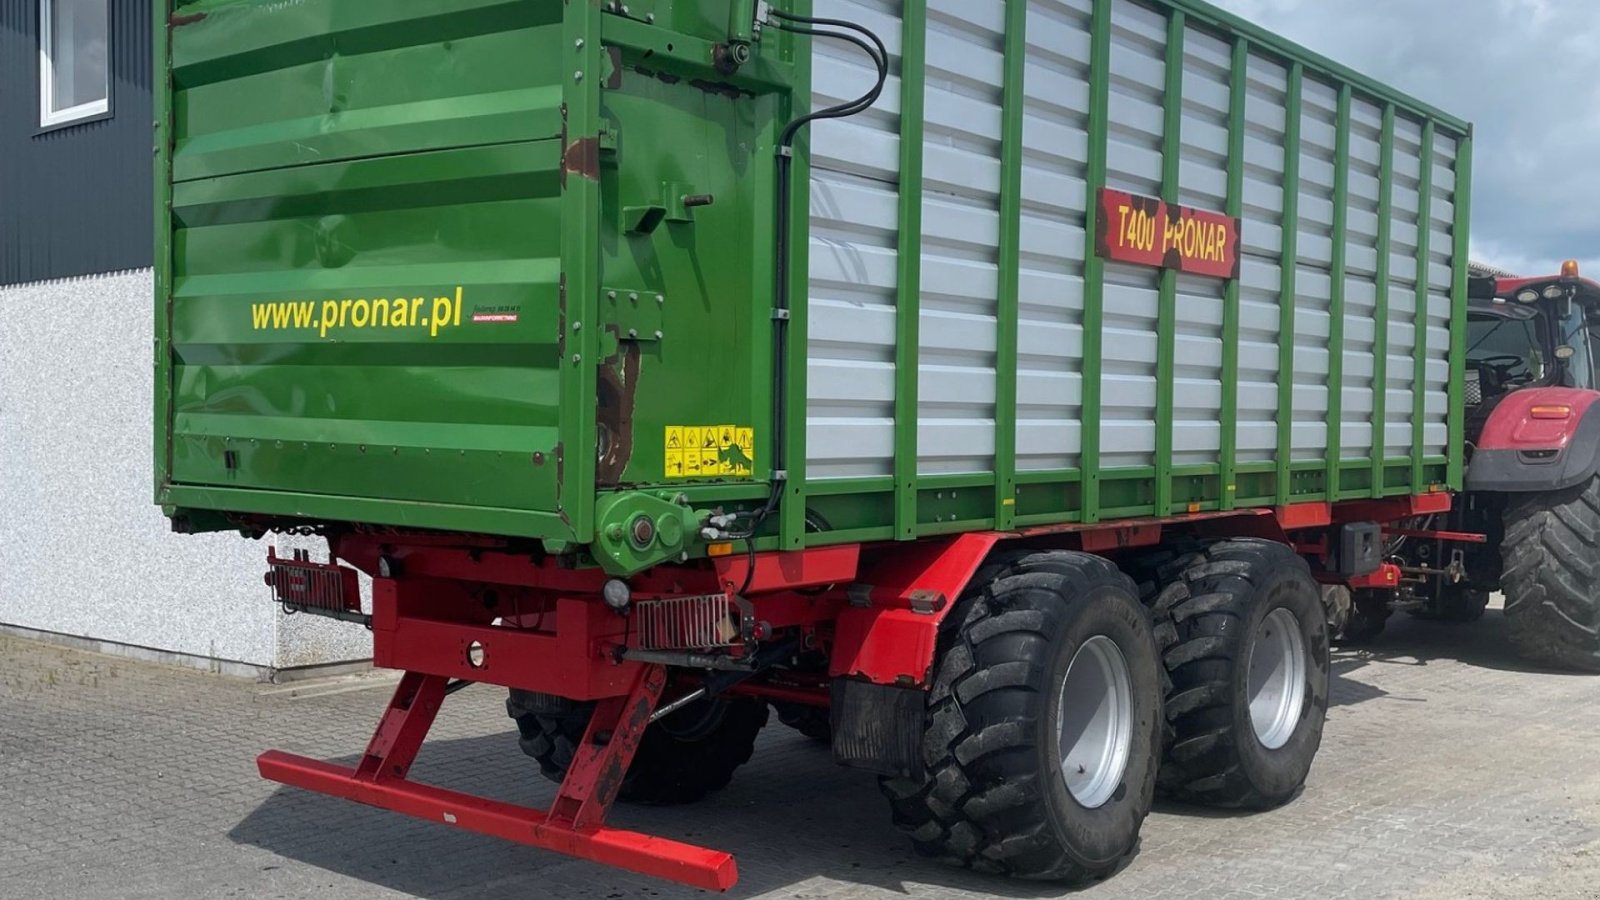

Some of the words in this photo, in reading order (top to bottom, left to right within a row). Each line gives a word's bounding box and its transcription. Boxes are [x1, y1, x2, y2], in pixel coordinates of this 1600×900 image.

[1118, 205, 1156, 252] T400
[1162, 214, 1227, 263] PRONAR
[252, 286, 462, 337] www.pronar.pl
